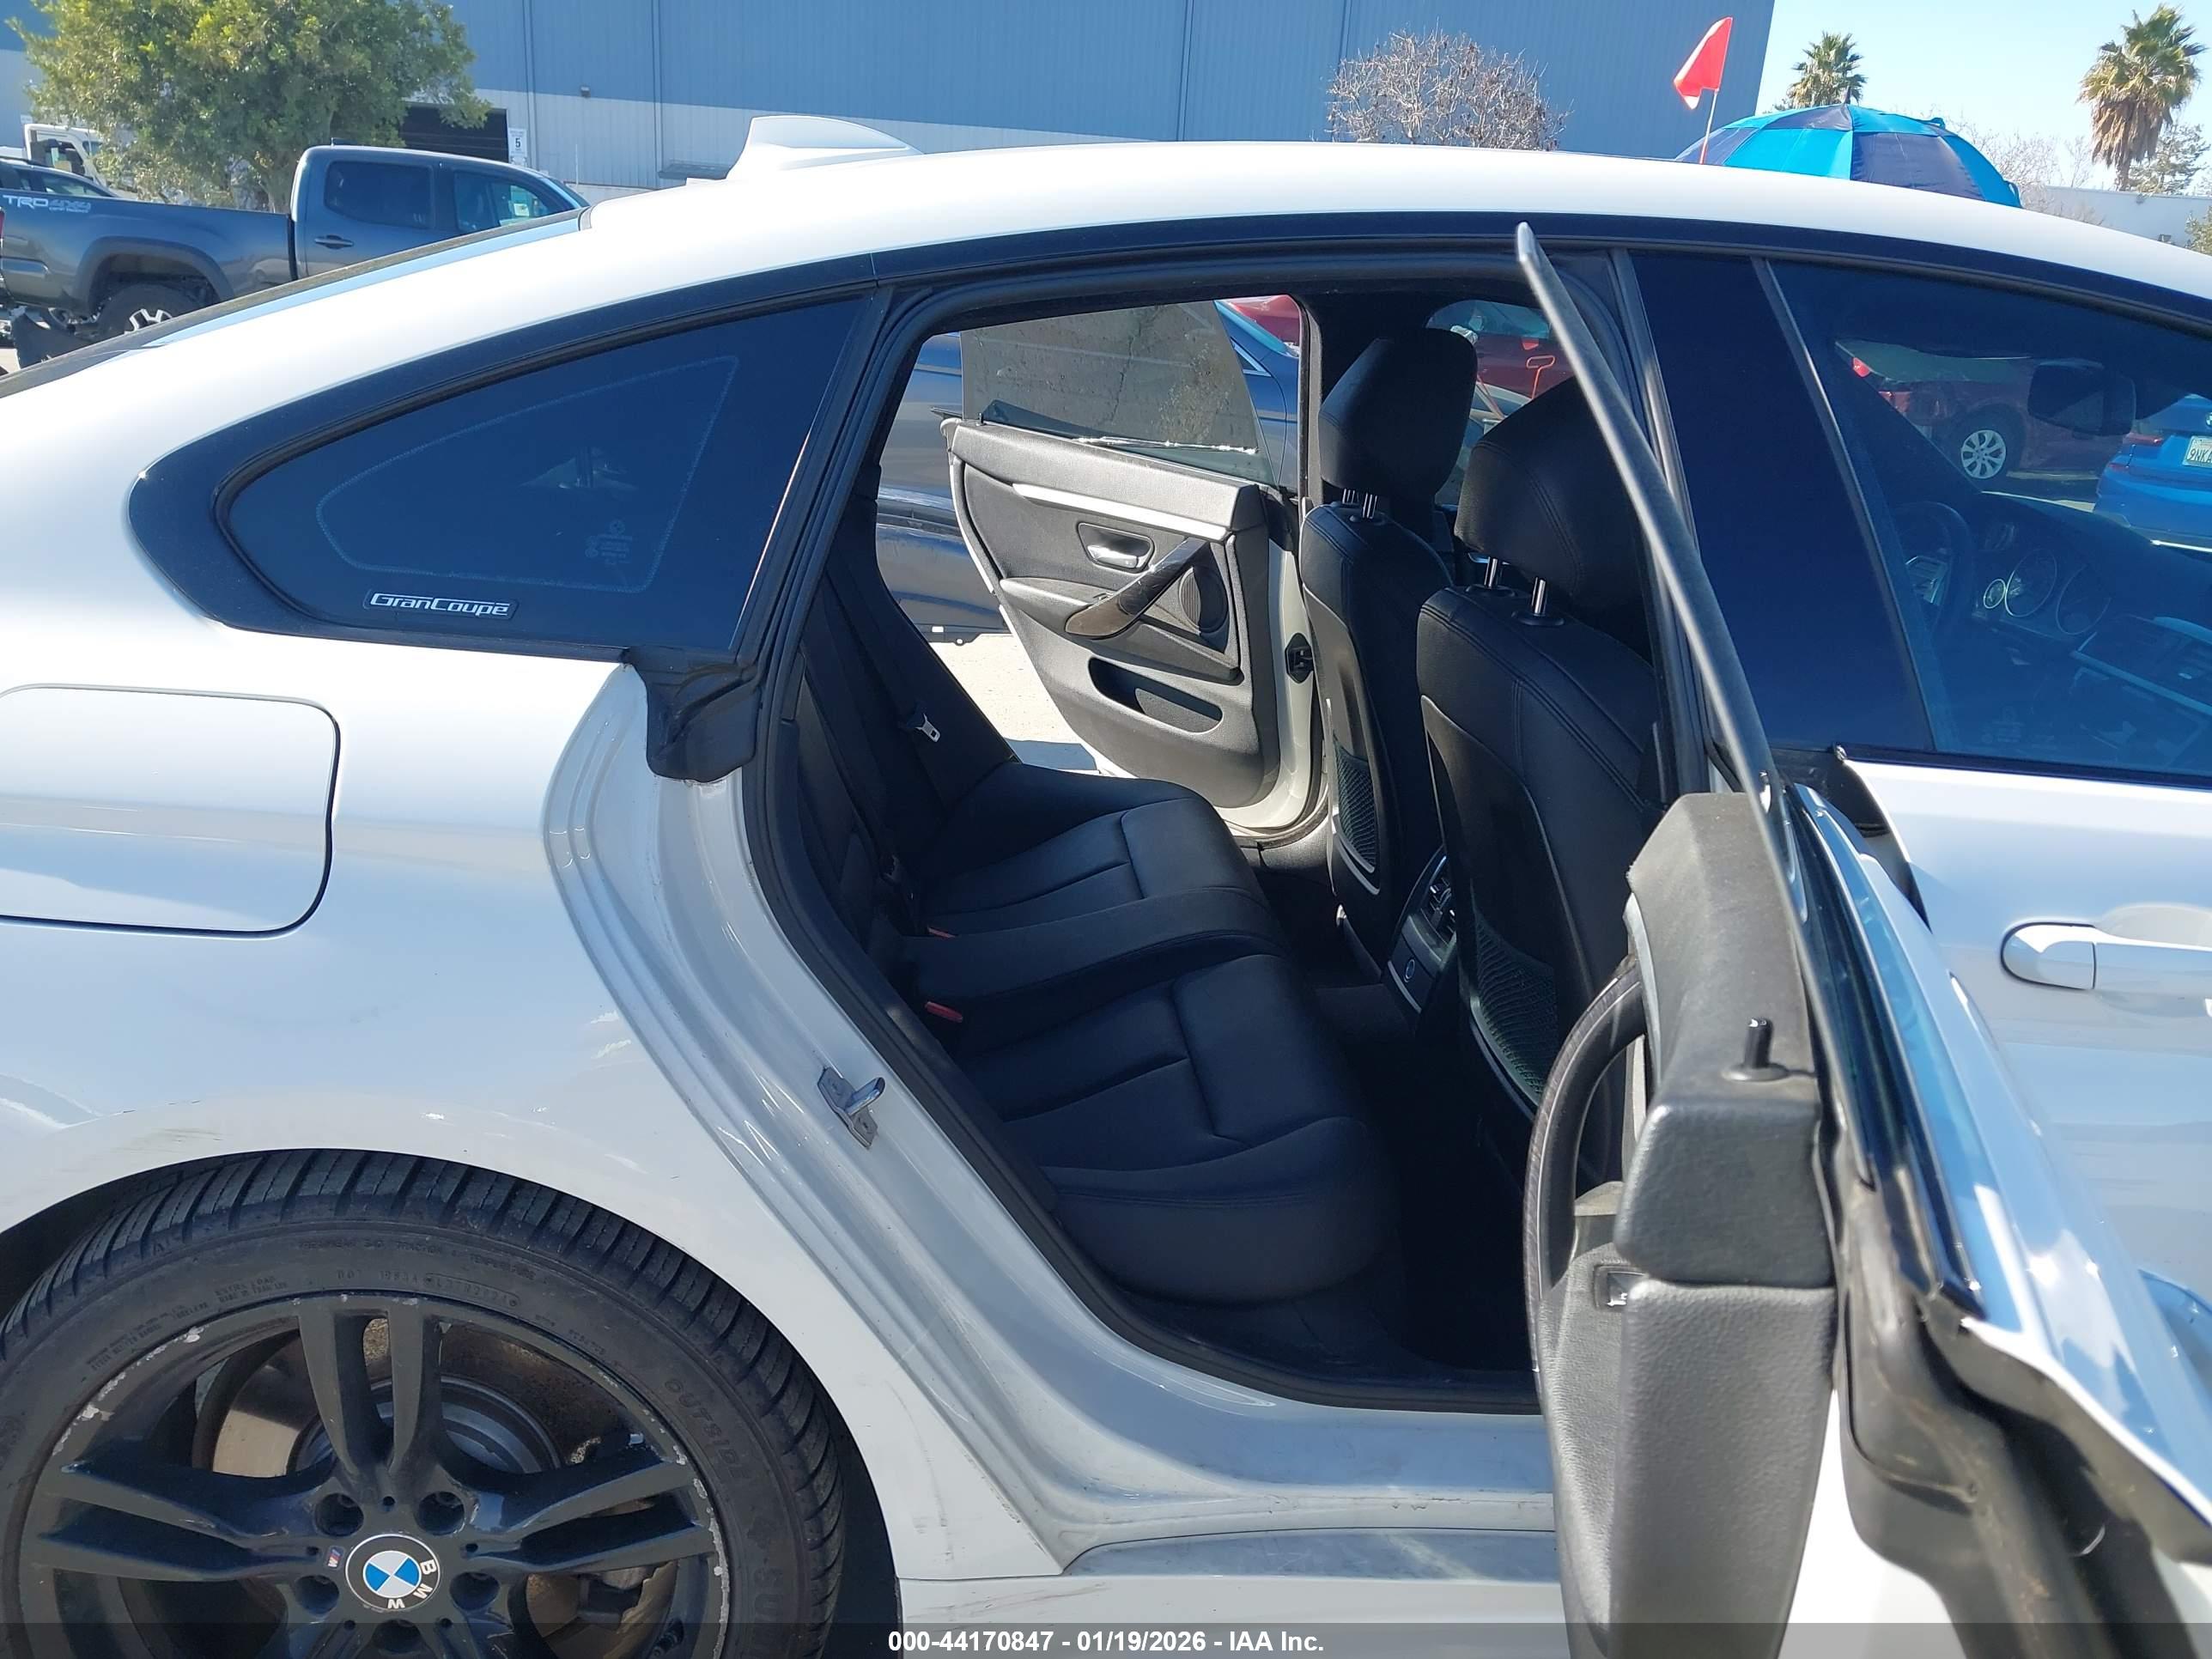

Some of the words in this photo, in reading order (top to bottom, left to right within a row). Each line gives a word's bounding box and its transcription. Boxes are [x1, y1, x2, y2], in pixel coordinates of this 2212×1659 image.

[515, 137, 521, 149] 5
[3, 194, 49, 209] TRD
[665, 1378, 752, 1479] OUTSIDE
[386, 1559, 438, 1609] BMW
